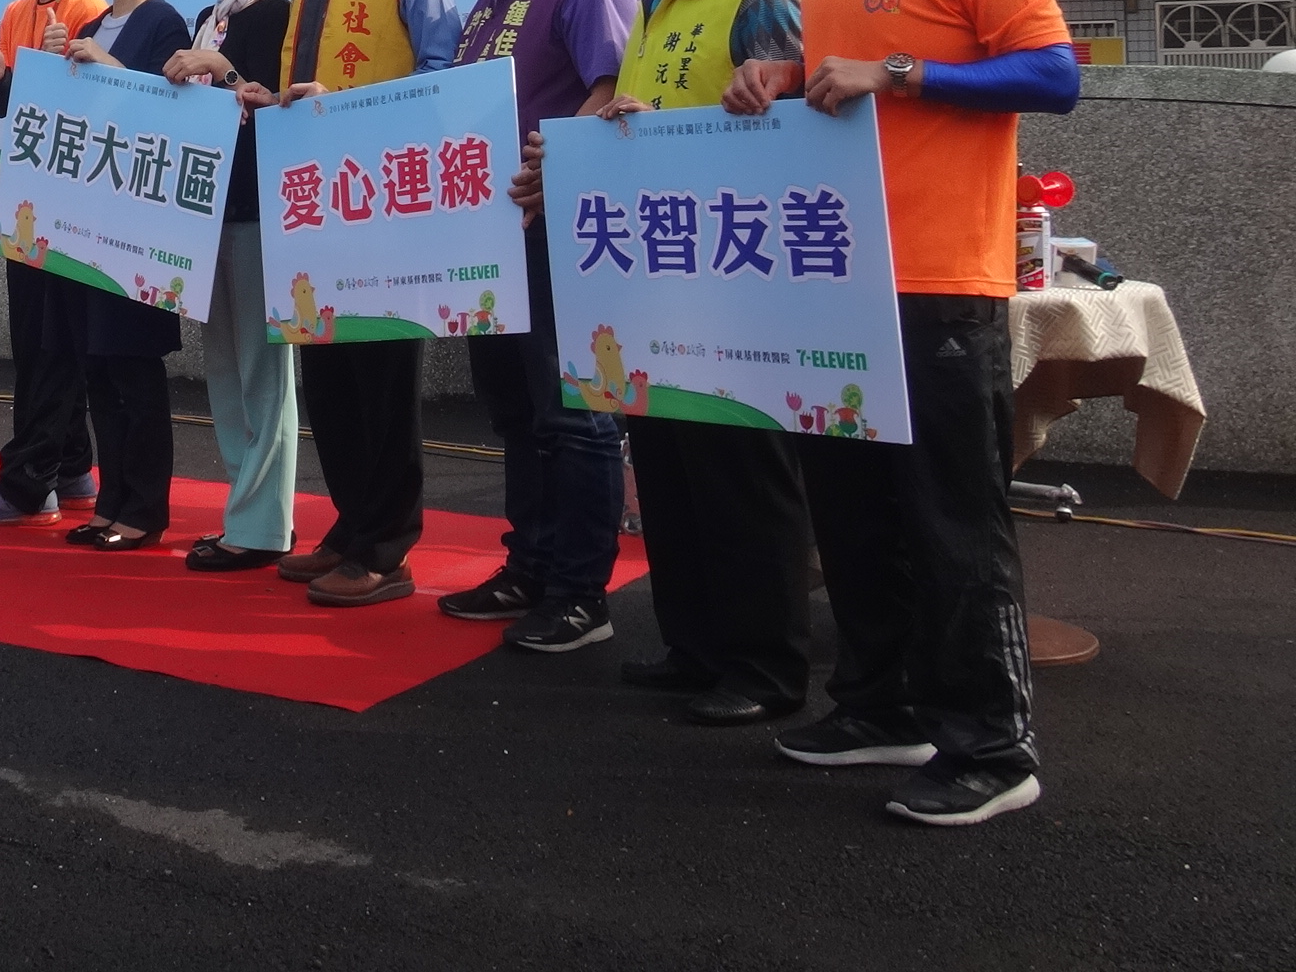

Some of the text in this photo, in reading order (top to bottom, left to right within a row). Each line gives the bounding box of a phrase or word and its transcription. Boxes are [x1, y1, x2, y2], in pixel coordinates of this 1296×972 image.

[333, 1, 372, 90] 社會
[9, 105, 222, 216] 安居大社區
[280, 137, 492, 232] 愛心連線
[575, 191, 852, 278] 失智友善
[725, 348, 791, 365] 屏東基督教醫院
